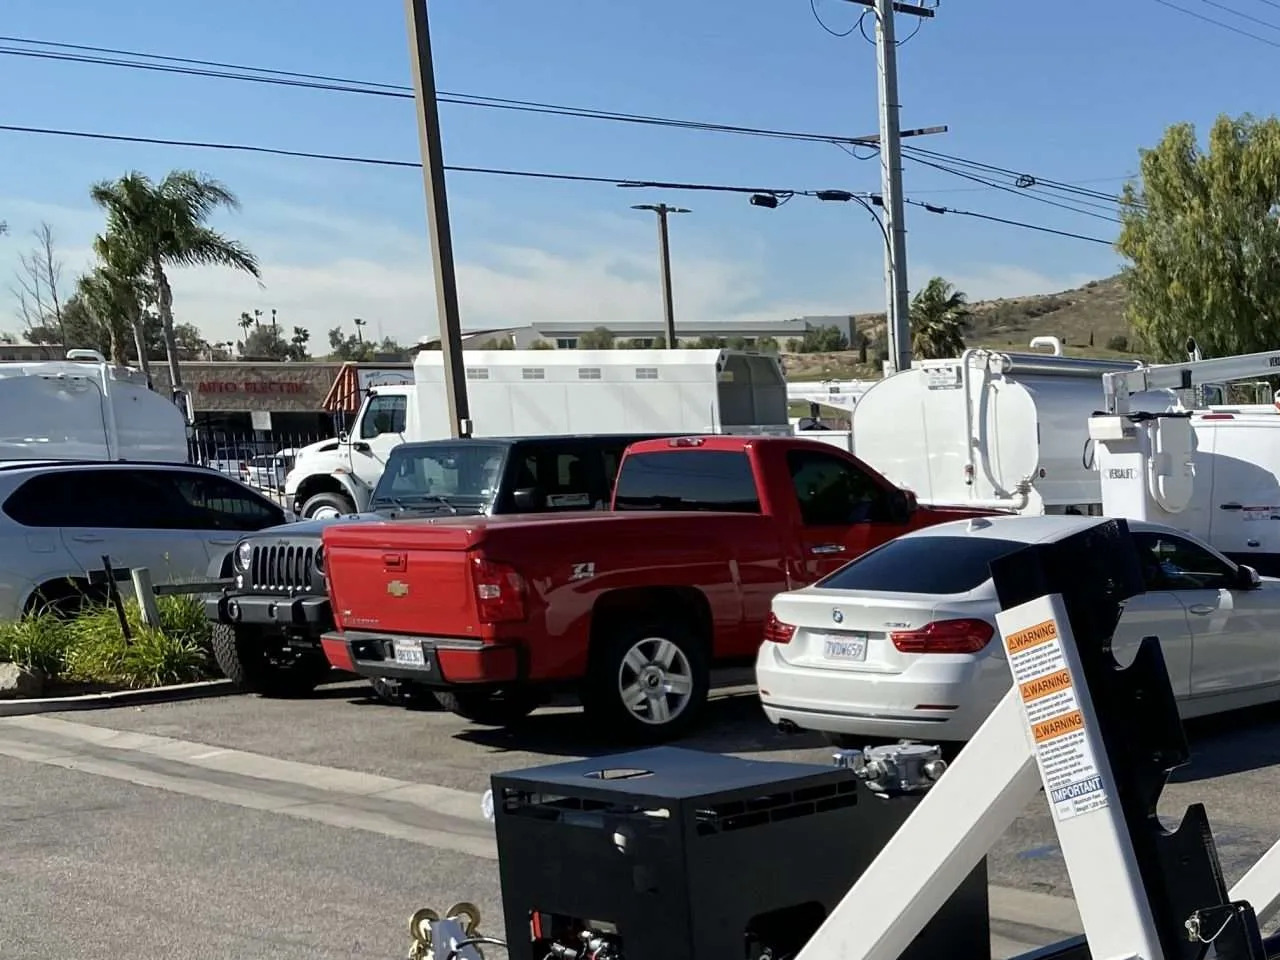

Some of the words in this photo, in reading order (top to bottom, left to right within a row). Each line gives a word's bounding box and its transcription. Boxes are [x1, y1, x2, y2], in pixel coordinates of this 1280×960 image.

[1109, 467, 1134, 480] VERSALIFT
[1015, 623, 1056, 646] WARNING
[1029, 672, 1070, 695] WARNING
[1041, 714, 1082, 736] WARNING
[1052, 777, 1101, 803] IMPORTANT
